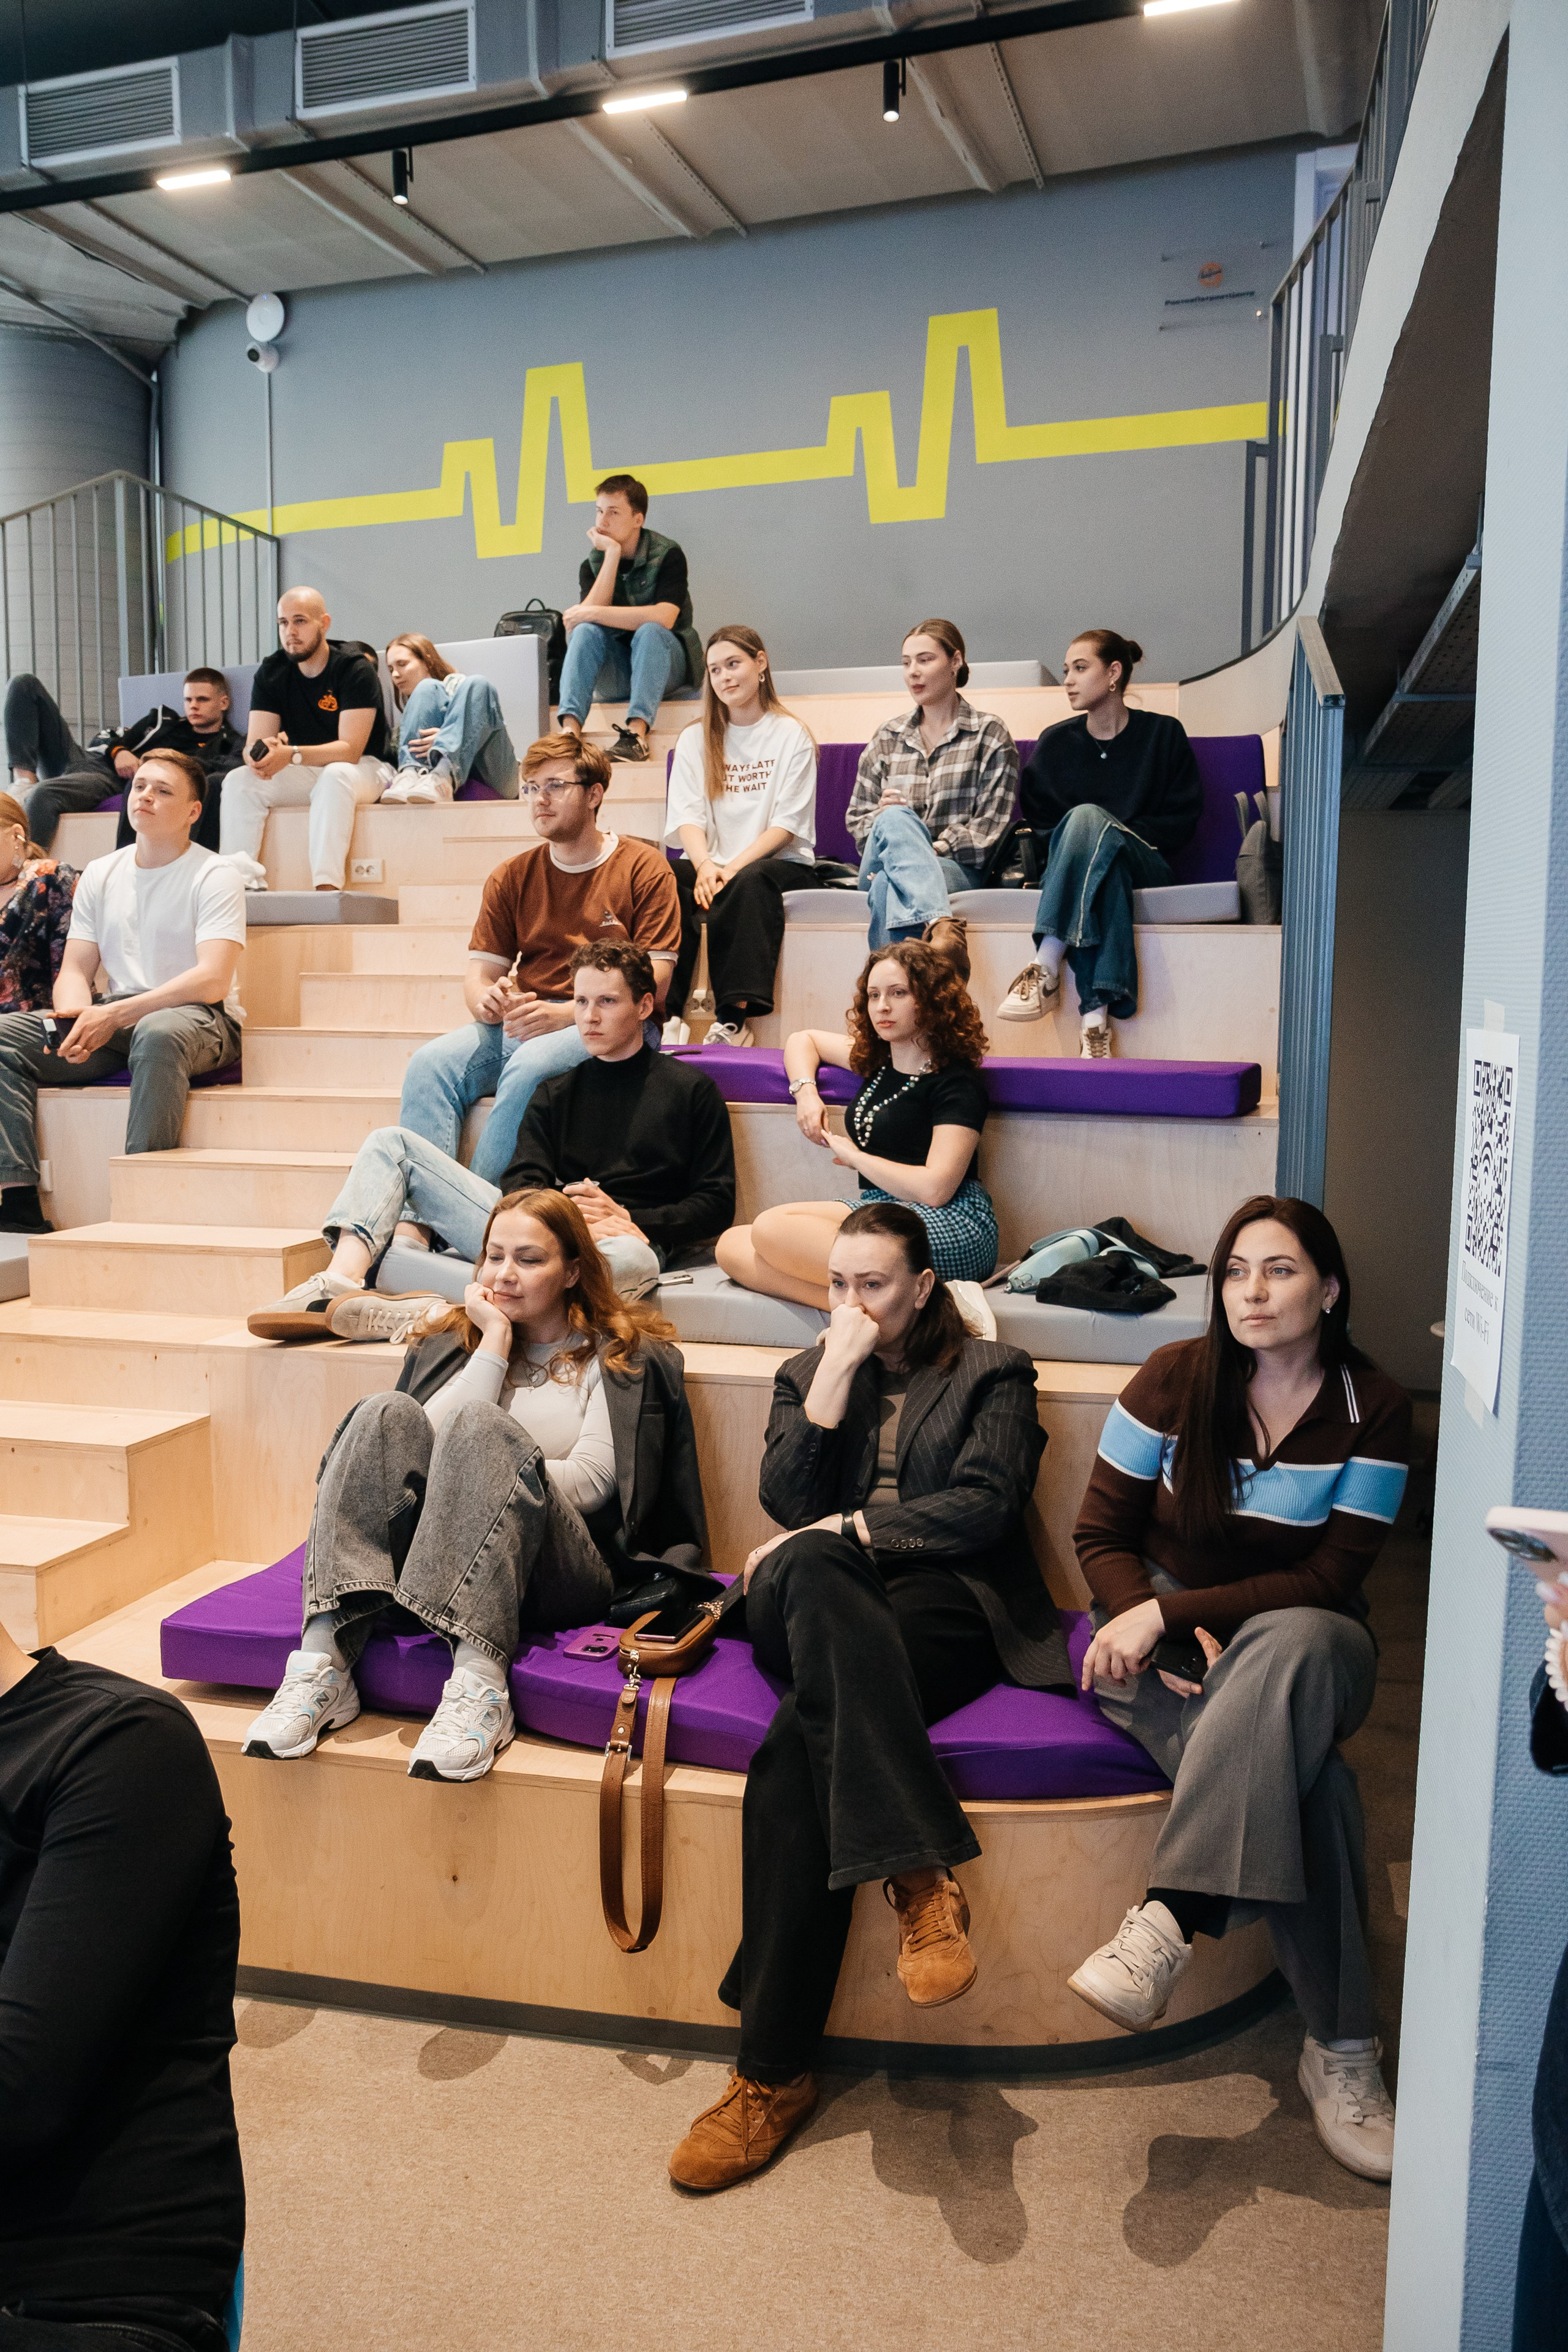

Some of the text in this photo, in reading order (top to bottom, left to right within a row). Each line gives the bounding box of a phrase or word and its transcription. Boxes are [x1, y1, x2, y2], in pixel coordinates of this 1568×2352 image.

[725, 782, 767, 793] HE WAIT
[738, 771, 772, 782] WORTH
[1461, 1260, 1498, 1312] Подключение к
[1464, 1307, 1490, 1345] сети Wi-Fi
